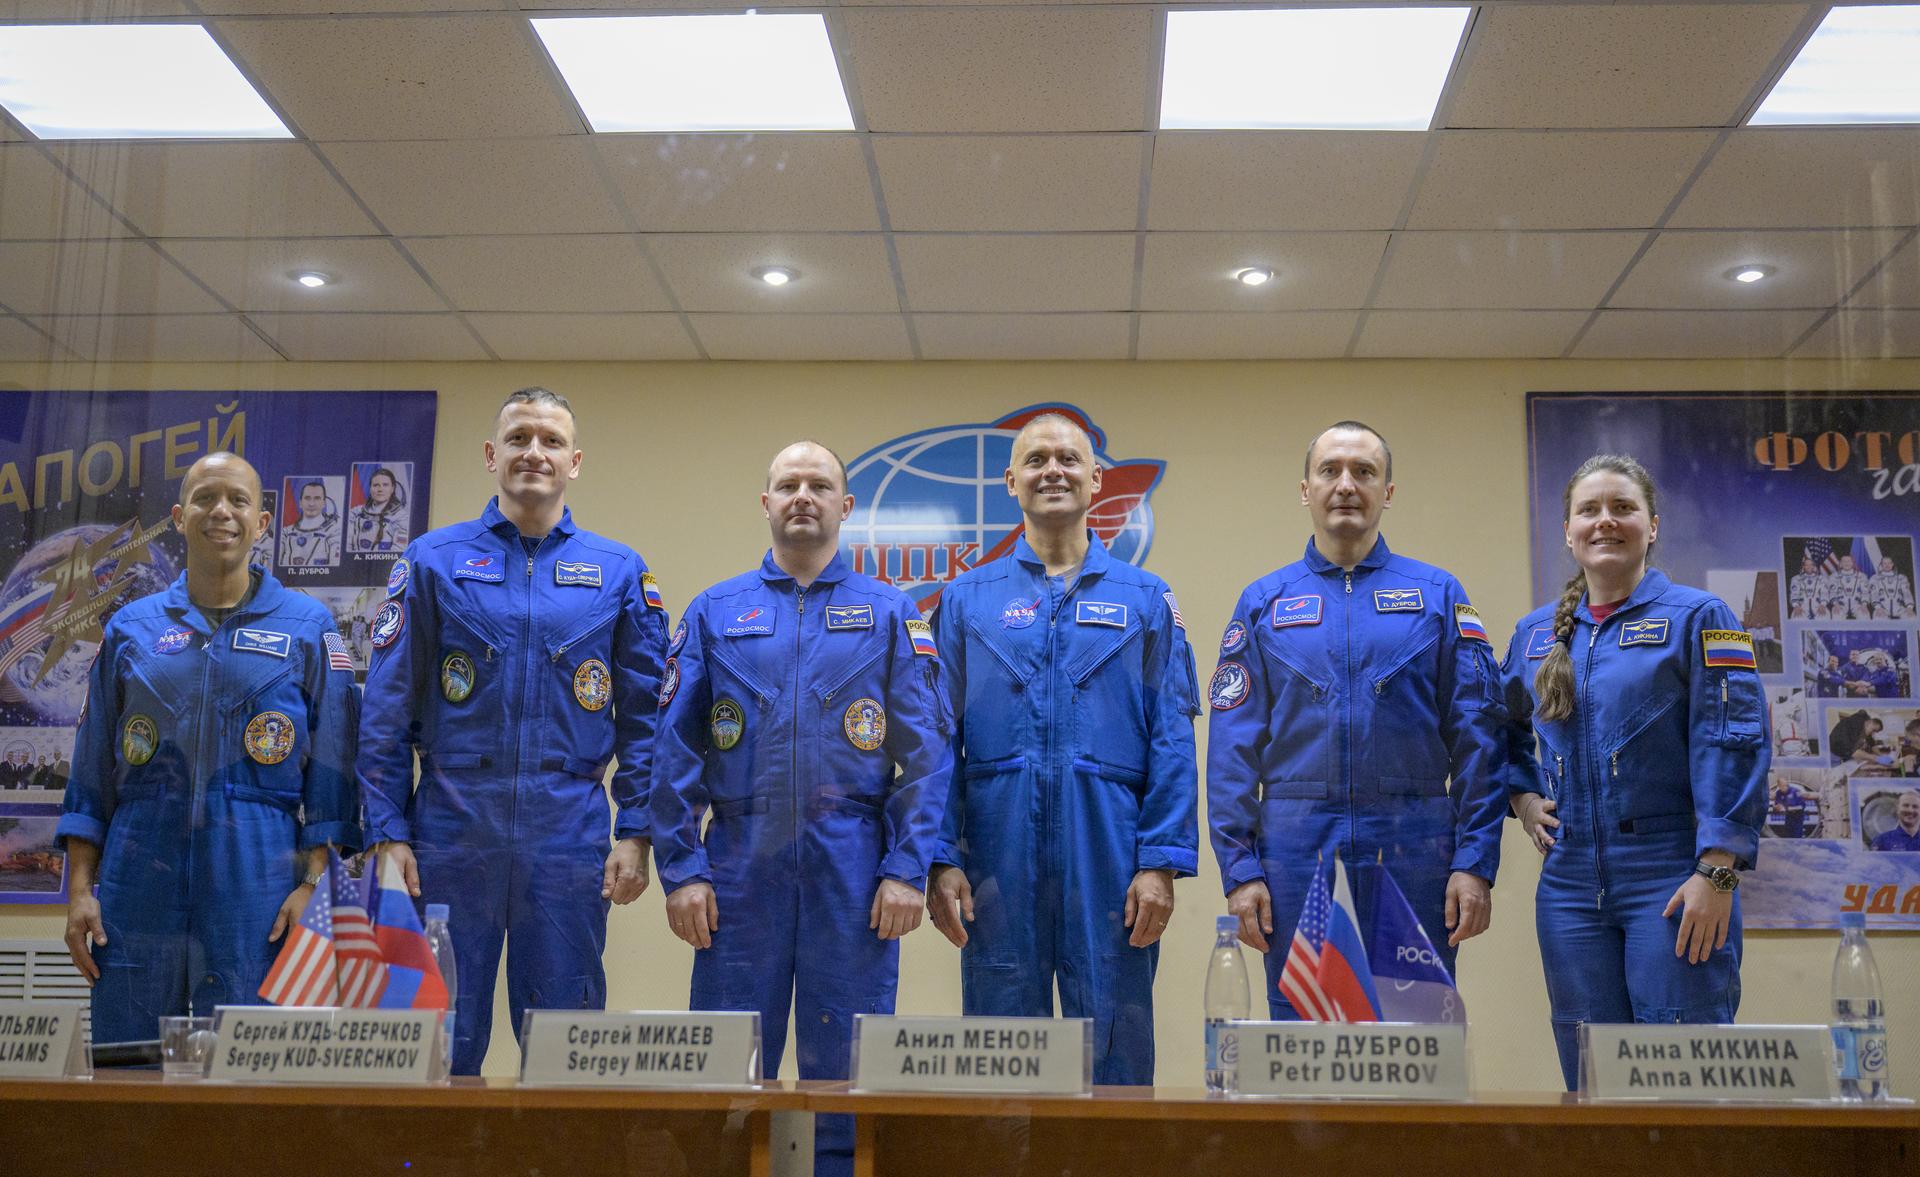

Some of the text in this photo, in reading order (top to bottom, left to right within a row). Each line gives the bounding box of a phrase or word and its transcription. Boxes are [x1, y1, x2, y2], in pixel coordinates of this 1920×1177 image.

[0, 400, 246, 512] АПОГЕЙ
[1755, 431, 1920, 471] ФОТО
[365, 553, 400, 561] КИКИНА
[849, 543, 980, 587] ЦПК
[56, 554, 90, 590] 74
[288, 567, 330, 575] П. ДУБРОВ
[455, 569, 501, 579] РОСКОСМОС
[1004, 609, 1035, 618] NASA
[1276, 613, 1317, 622] РОСКОСМОС
[69, 614, 97, 636] МКС
[727, 625, 770, 633] РОСКОСМОС
[158, 634, 191, 644] NASA
[1705, 632, 1751, 643] РОССИЯ
[1840, 884, 1920, 913] УДА
[0, 1016, 59, 1036] ЛЬЯМС
[233, 1020, 422, 1045] Сергей КУДЬ-СВЕРЧКОВ
[568, 1024, 714, 1049] Сергей МИКАЕВ
[895, 1028, 1048, 1050] Анил МЕНОН
[1265, 1033, 1325, 1059] Пётр
[1335, 1035, 1440, 1058] ДУБРОВ
[1617, 1038, 1799, 1060] Анна КИКИНА
[0, 1042, 49, 1062] LIAMS
[227, 1047, 419, 1072] Sergey KUD-SVERCHKOV
[568, 1051, 708, 1076] Sergey MIKAEV
[900, 1054, 1040, 1077] Anil MENON
[1269, 1061, 1438, 1084] Petr DUBROV
[1629, 1066, 1796, 1088] Anna KIKINA
